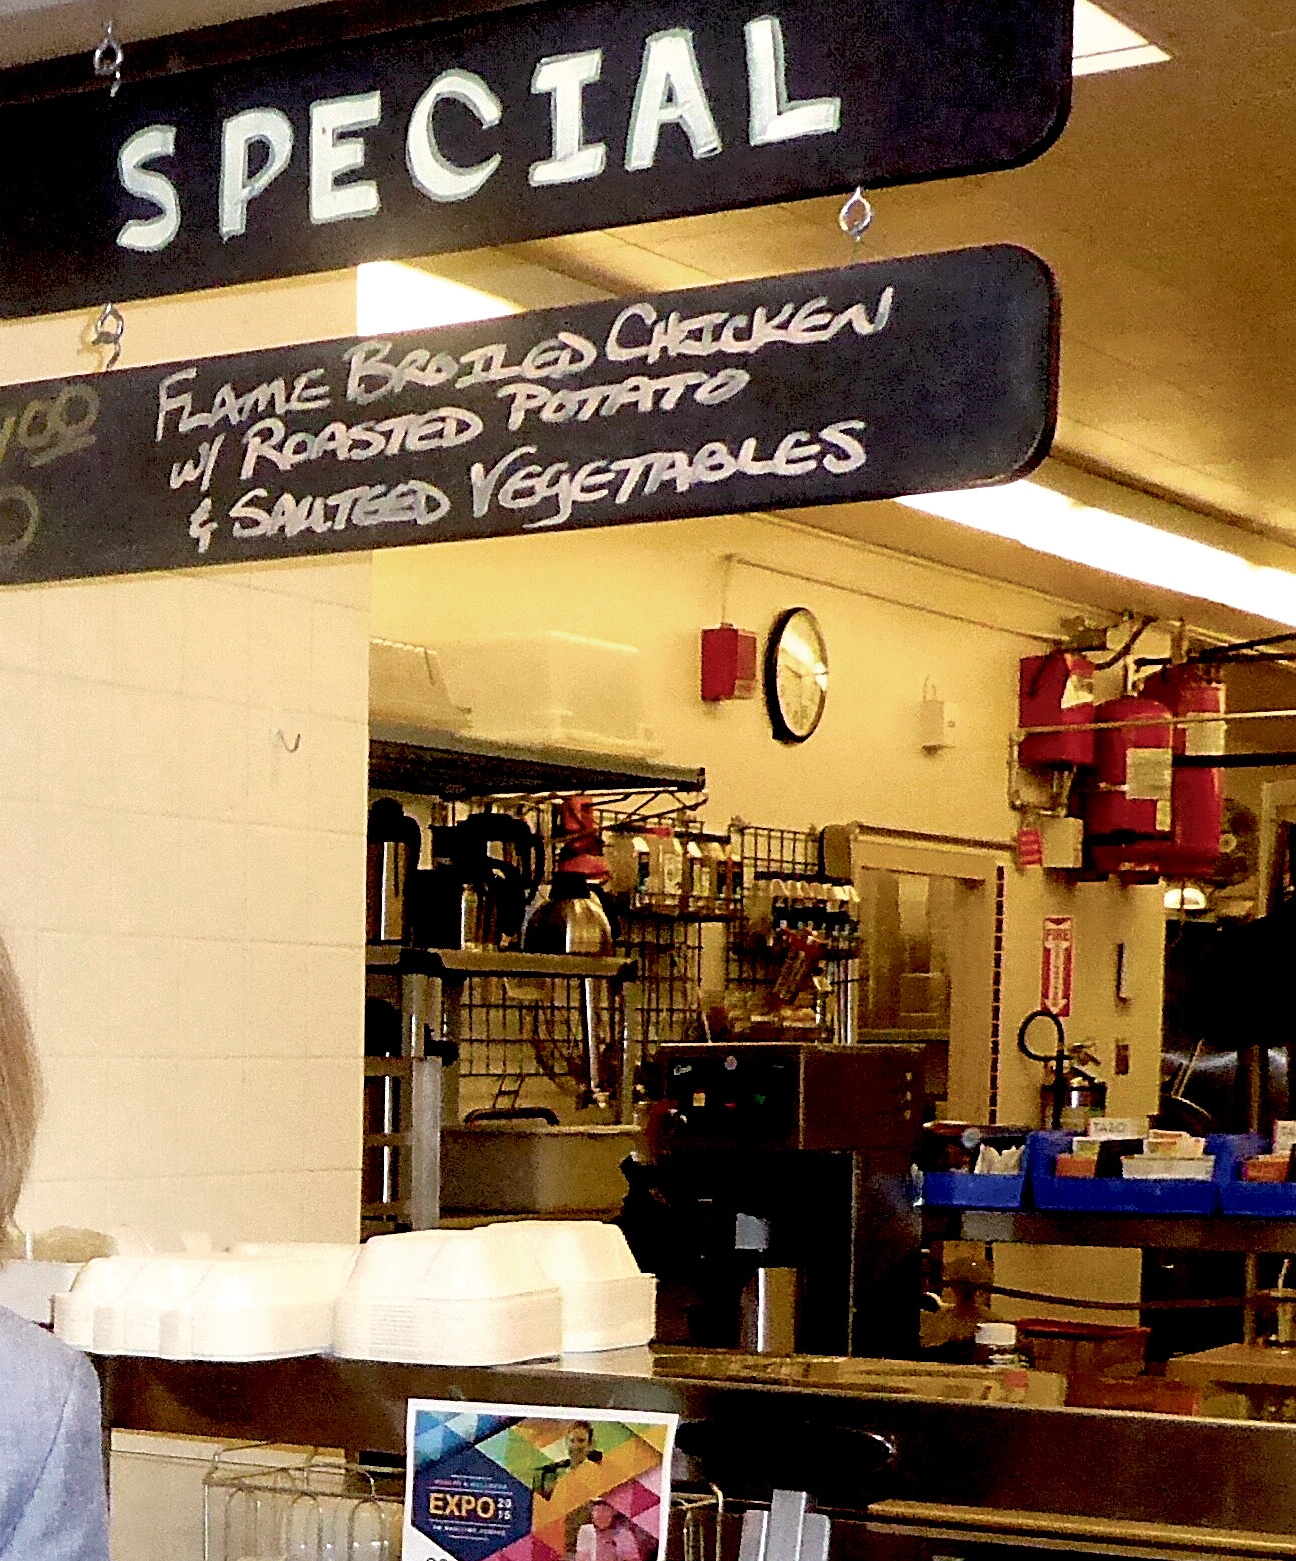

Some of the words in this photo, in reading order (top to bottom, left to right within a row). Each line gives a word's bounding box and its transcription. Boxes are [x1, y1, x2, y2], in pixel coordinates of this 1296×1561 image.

[116, 15, 841, 253] SPECIAL
[155, 367, 330, 442] FLAME
[345, 332, 598, 404] BROILED
[605, 286, 895, 361] CHICKEN
[241, 406, 484, 482] ROASTED
[496, 369, 751, 431] POTATO
[470, 419, 869, 530] VEGETABLES
[429, 1493, 496, 1518] EXPO
